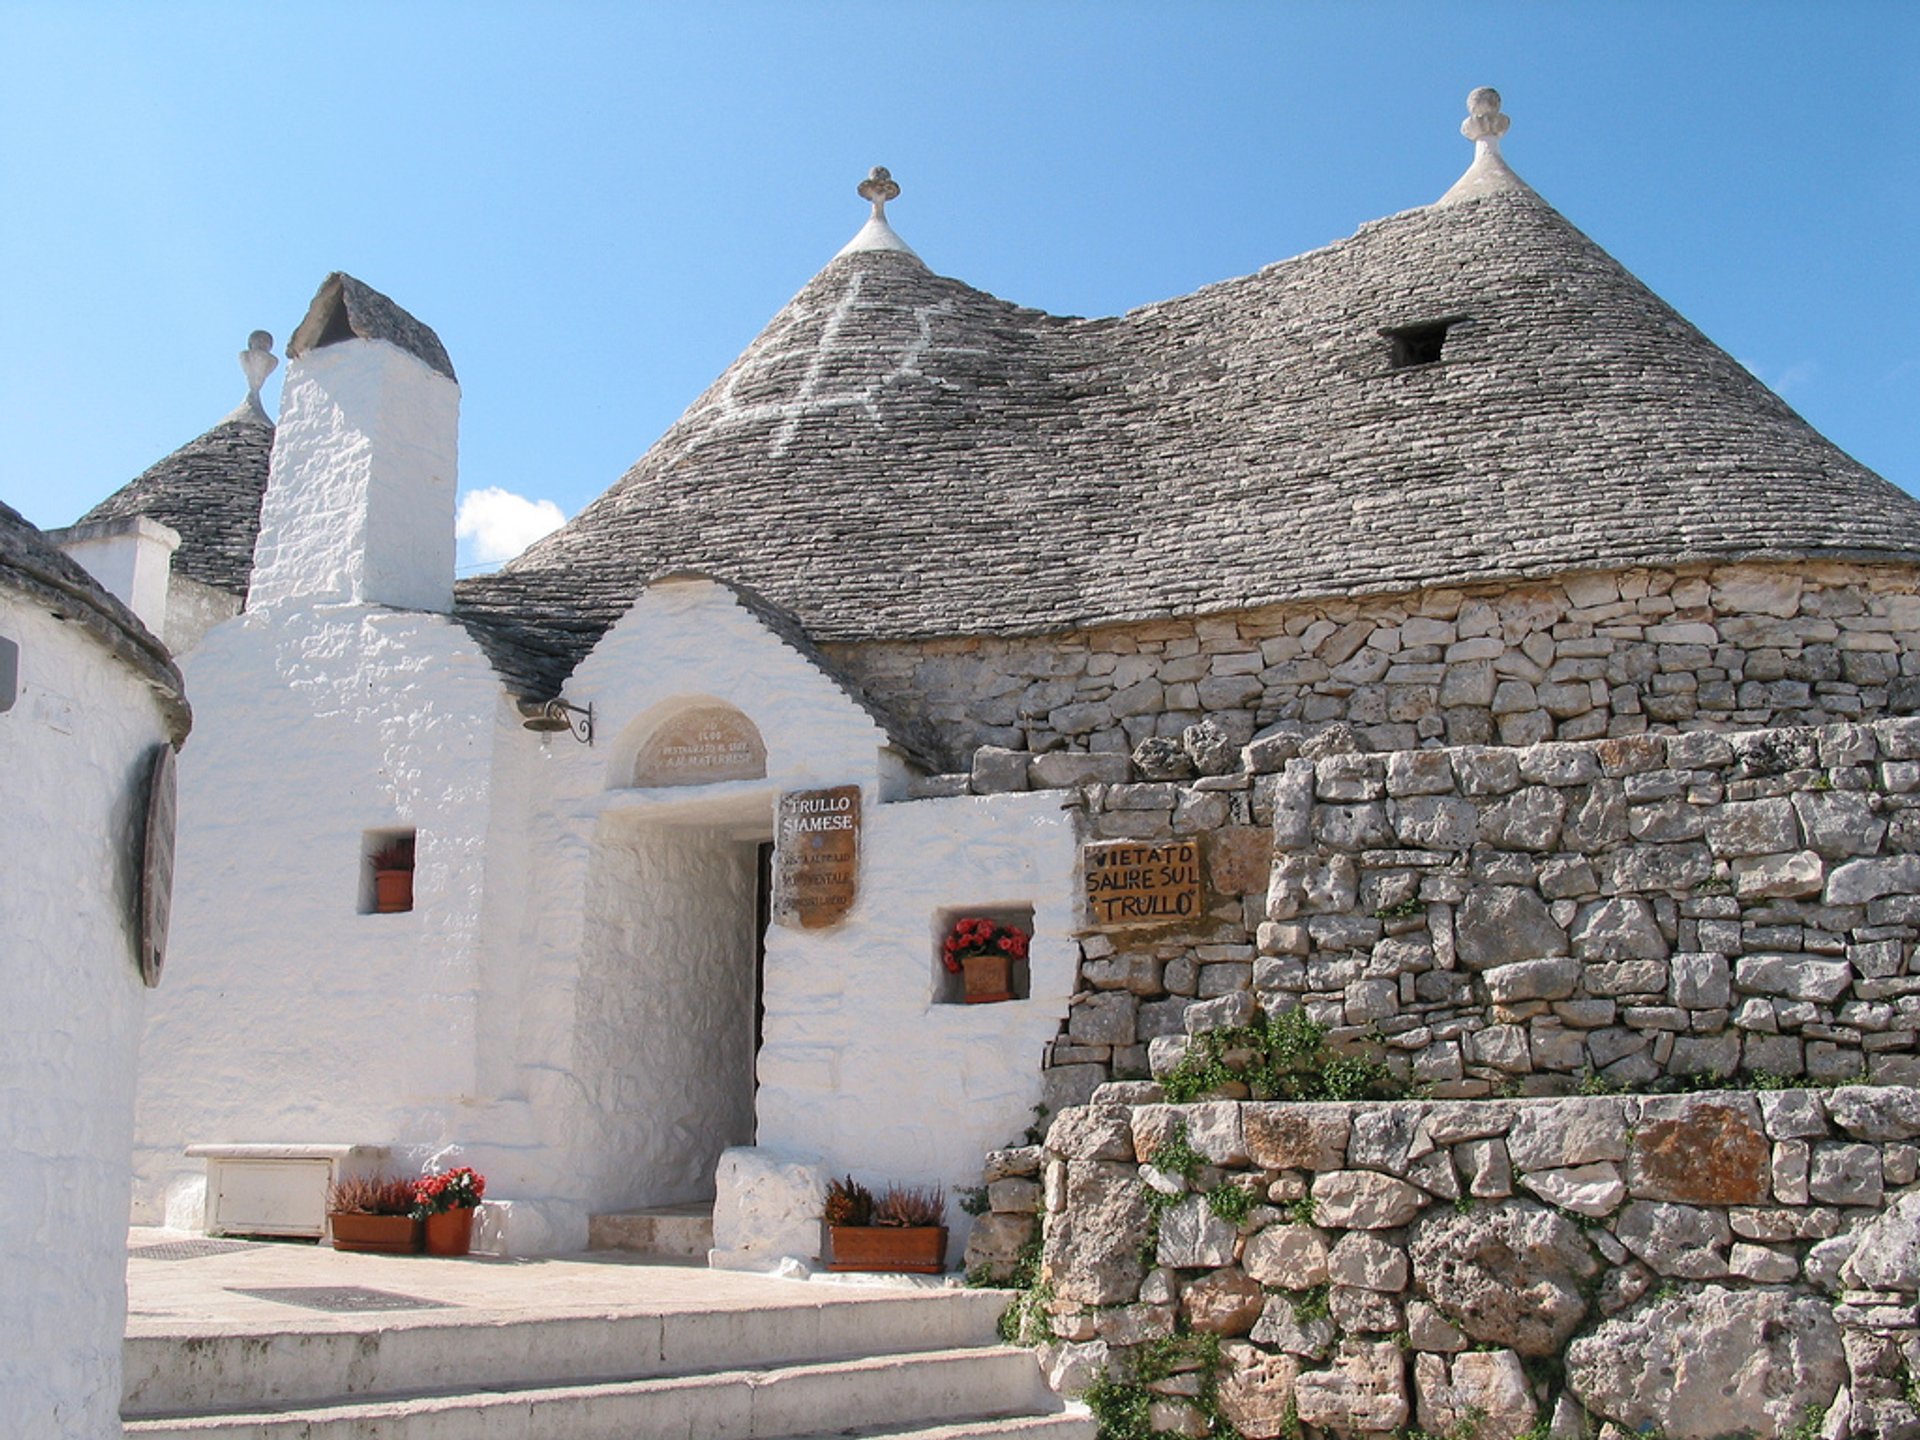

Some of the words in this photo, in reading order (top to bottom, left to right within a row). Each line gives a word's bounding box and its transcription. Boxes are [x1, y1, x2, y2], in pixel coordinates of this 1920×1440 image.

[786, 796, 851, 814] TRULLO
[783, 815, 853, 833] SIAMESE
[1161, 867, 1200, 887] SUL
